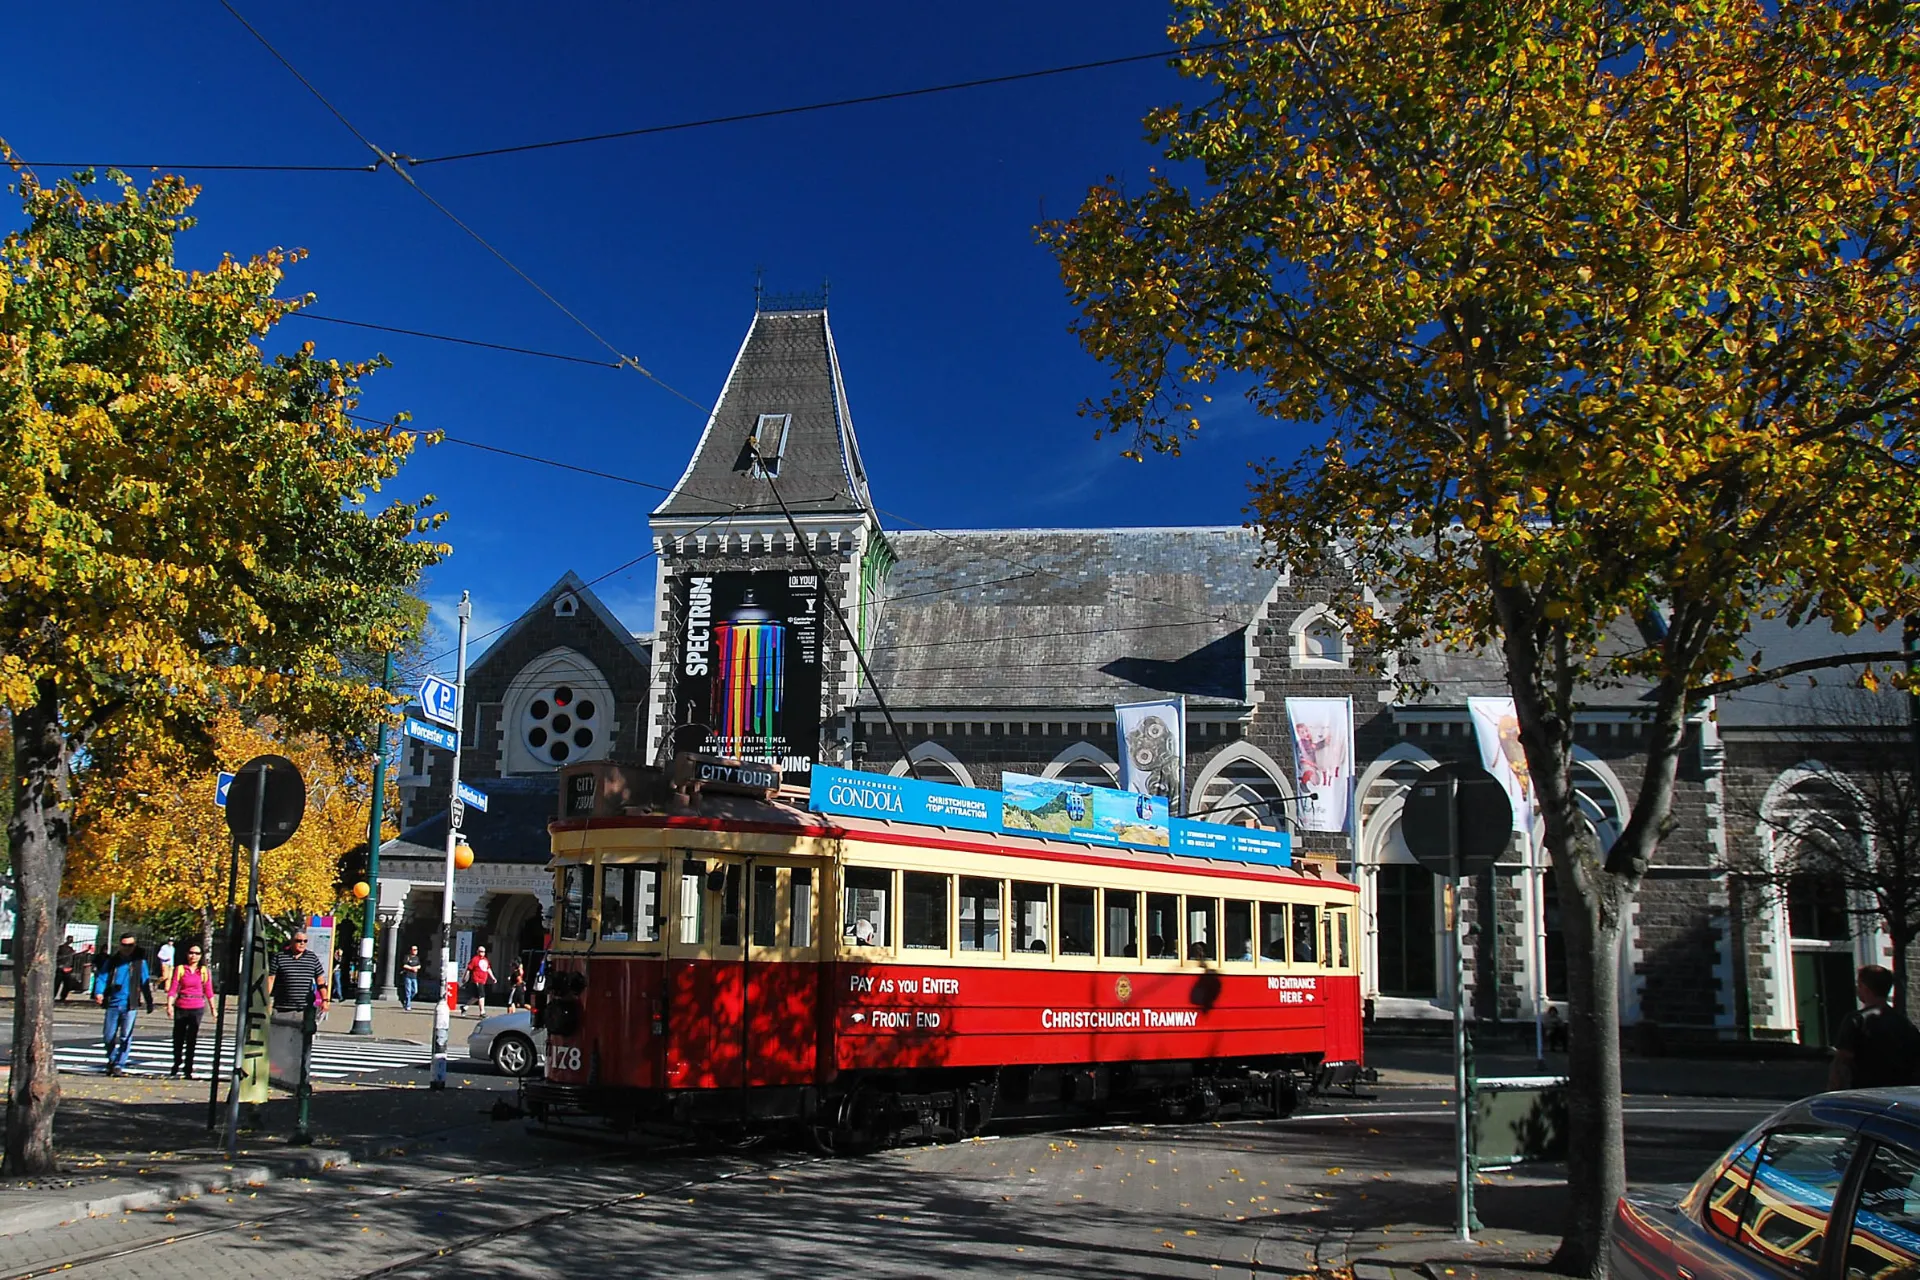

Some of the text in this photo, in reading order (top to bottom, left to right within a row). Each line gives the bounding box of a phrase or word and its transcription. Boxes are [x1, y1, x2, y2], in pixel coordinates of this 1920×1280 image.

[799, 576, 815, 585] YOU!
[685, 577, 713, 676] SPECTRUM
[441, 686, 451, 709] P
[410, 720, 455, 748] Worcester St
[705, 736, 729, 744] STEET
[756, 736, 768, 744] THE
[769, 736, 787, 744] YMCA
[698, 745, 711, 753] BIG
[711, 745, 733, 753] WLLS
[576, 776, 594, 792] CITY
[701, 764, 772, 788] CITY TOUR
[837, 777, 897, 791] CHRISTCHURCH
[829, 784, 904, 813] GONDOLA
[927, 795, 986, 811] CHRISTCHURCH'S
[945, 806, 988, 819] ATTRACTION
[850, 975, 959, 994] PAY AS YOU ENTER
[1267, 976, 1317, 990] NO ENTRANCE
[1280, 991, 1303, 1004] HERE
[871, 1011, 940, 1028] FRONT END
[1041, 1008, 1198, 1028] CHRISTCHURCH TRAMWAY
[551, 1045, 581, 1071] 178
